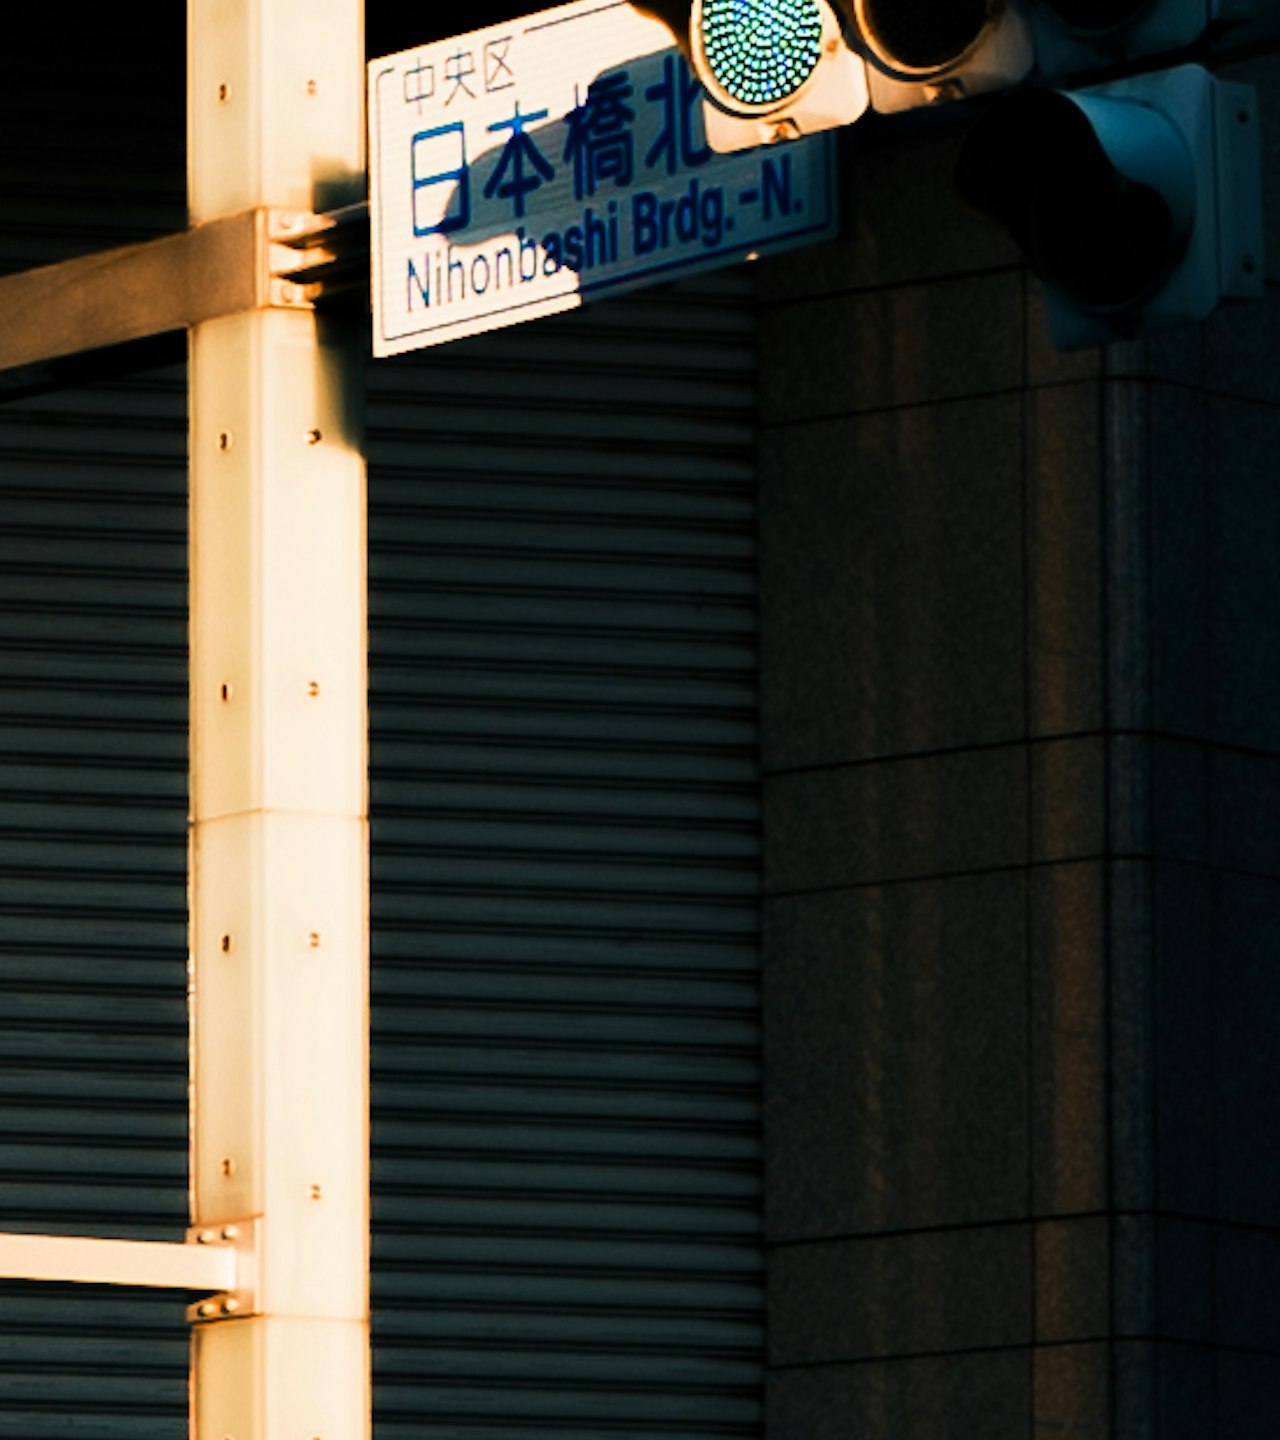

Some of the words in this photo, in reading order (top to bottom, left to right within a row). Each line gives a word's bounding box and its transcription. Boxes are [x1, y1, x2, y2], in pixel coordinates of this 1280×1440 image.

[404, 36, 515, 115] 中央区
[411, 55, 712, 237] 日本橋北
[406, 201, 617, 313] Nihonbashi
